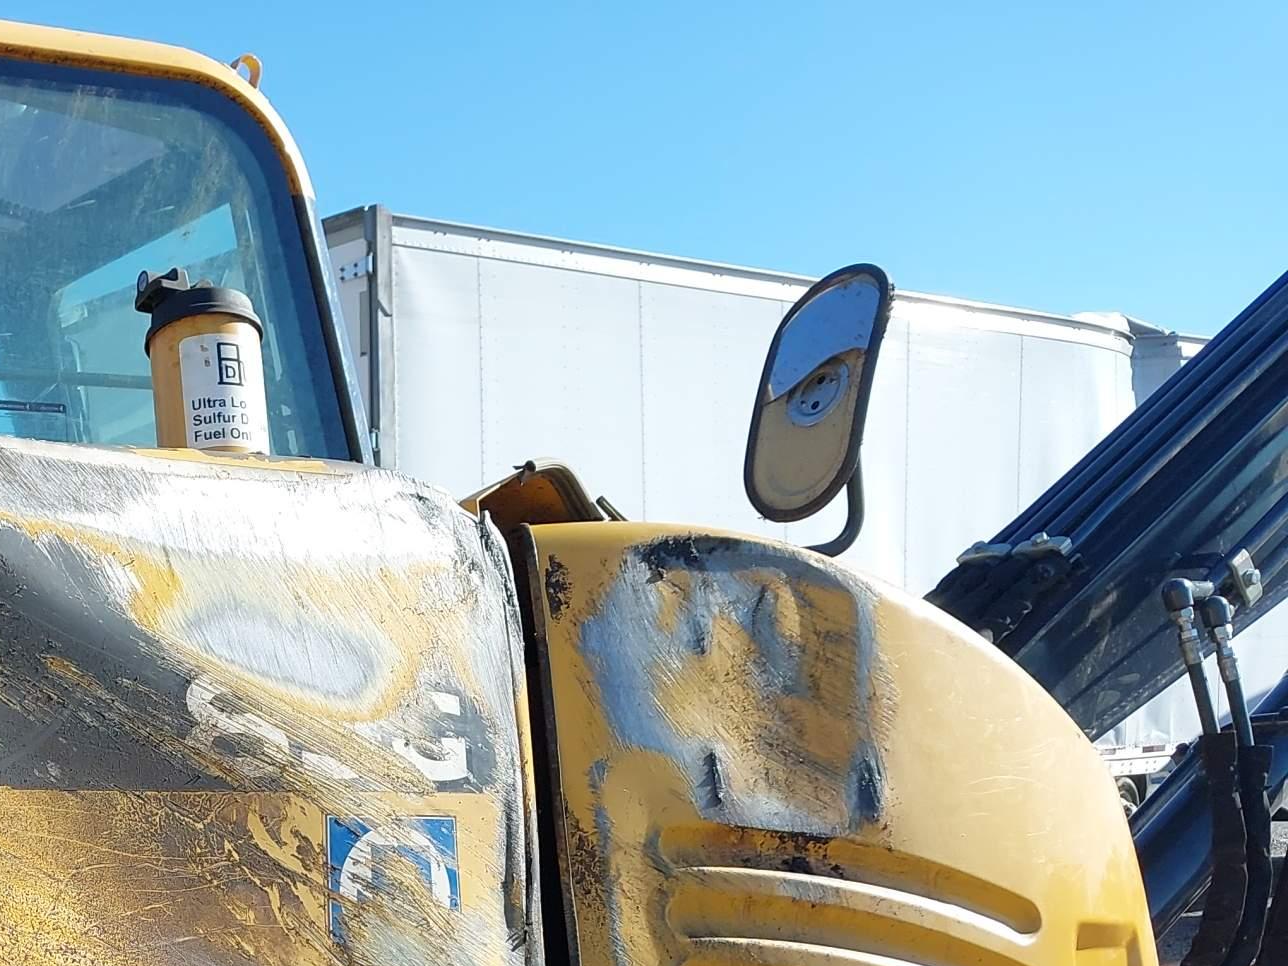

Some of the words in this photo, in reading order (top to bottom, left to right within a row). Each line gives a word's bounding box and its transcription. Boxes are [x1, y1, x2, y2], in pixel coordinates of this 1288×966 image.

[192, 396, 226, 411] Ultra
[193, 411, 237, 426] Sulfur
[194, 427, 226, 443] Fuel
